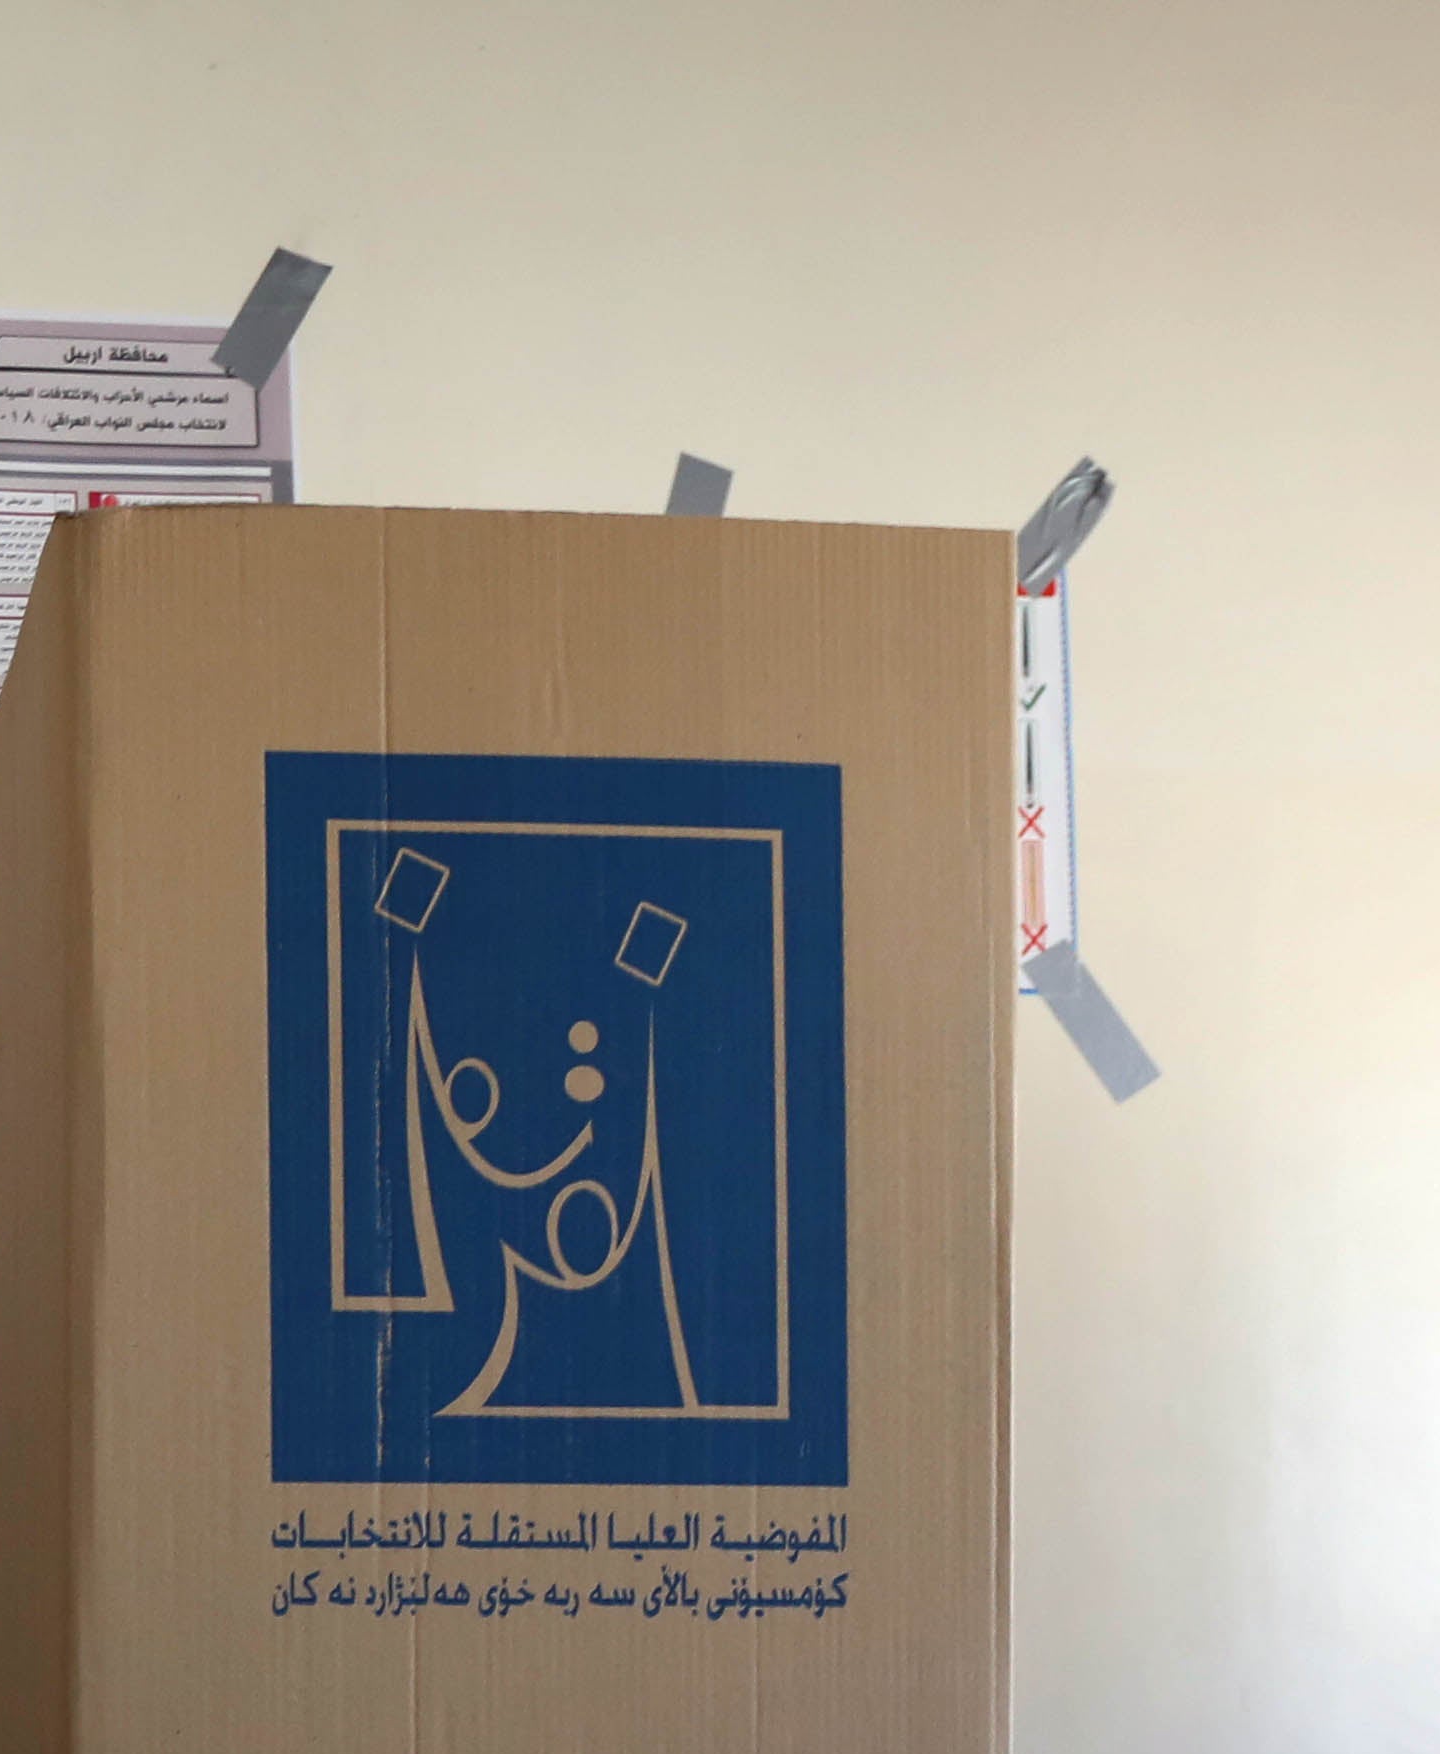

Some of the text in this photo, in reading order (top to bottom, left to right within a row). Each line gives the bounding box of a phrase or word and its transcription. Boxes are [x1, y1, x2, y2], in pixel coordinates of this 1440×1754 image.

[63, 346, 169, 365] محافظة اربيل
[148, 391, 189, 407] مرشحي
[192, 393, 230, 405] اسماء
[94, 417, 132, 431] النواب
[137, 418, 175, 432] مجلس
[271, 1510, 847, 1563] المفوضية العليا المستقلة للانتخابات
